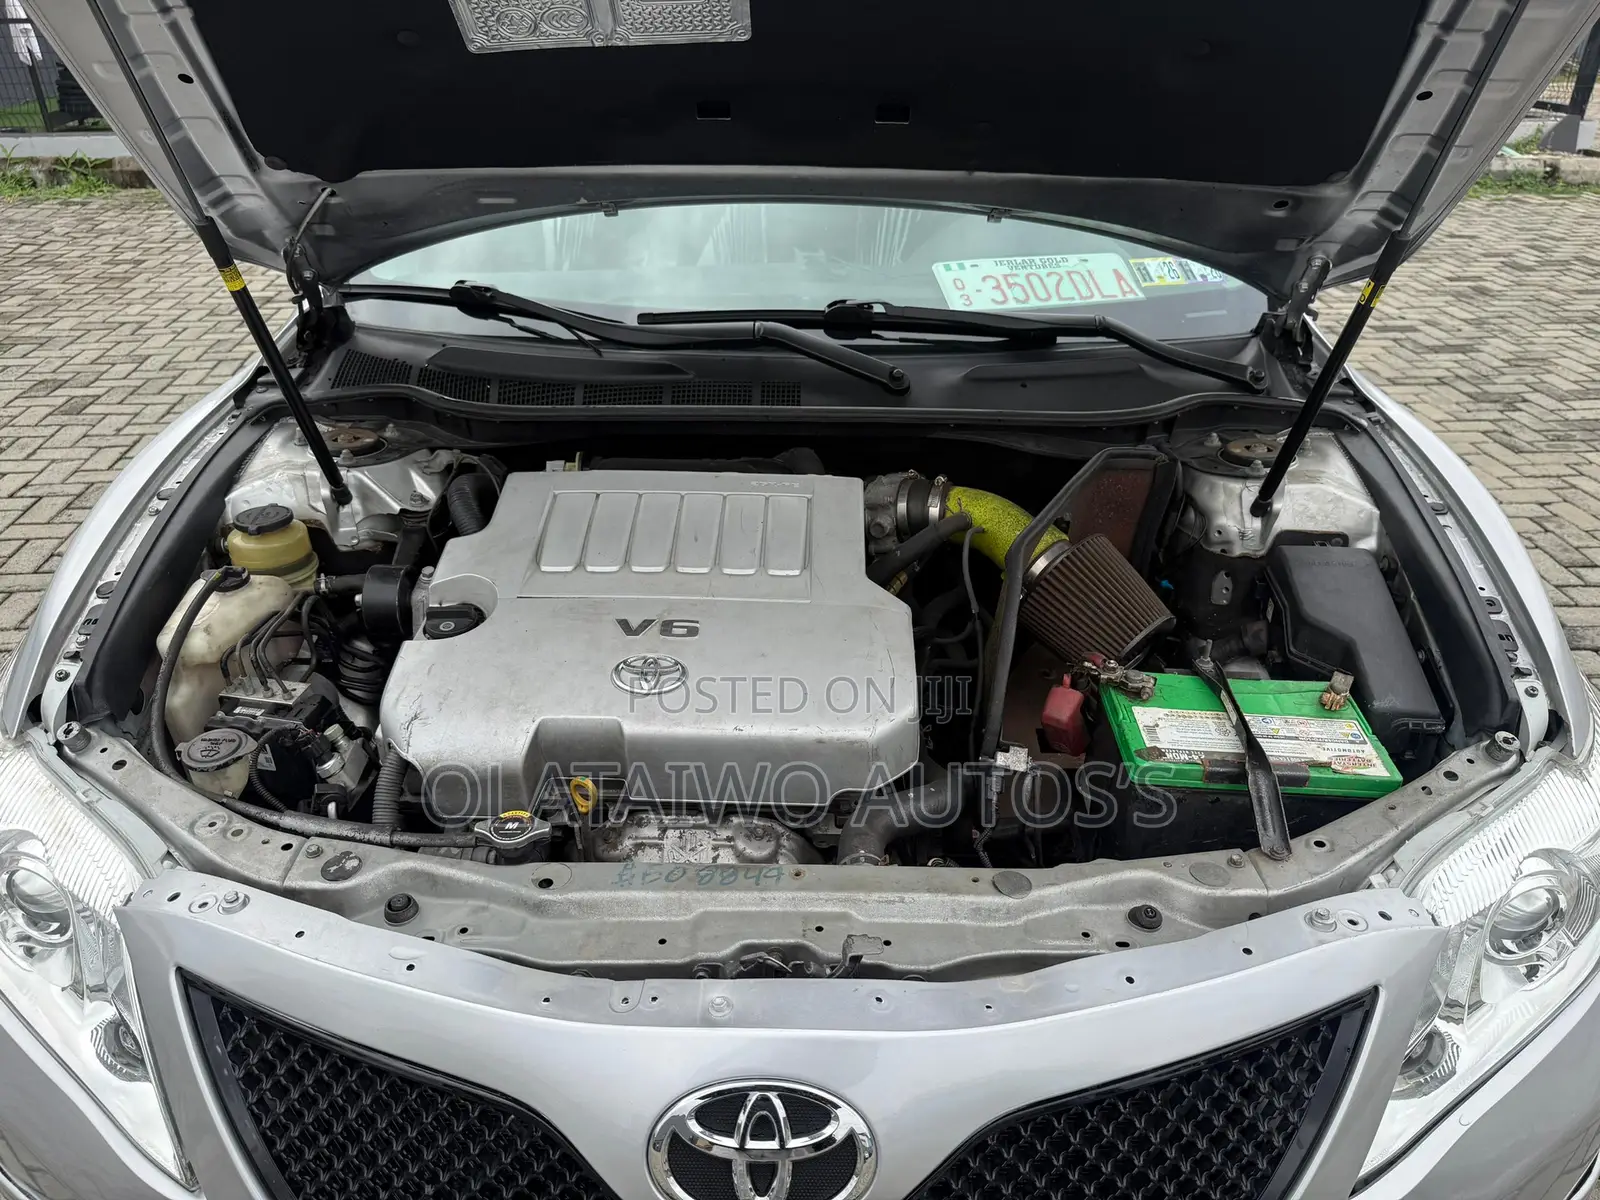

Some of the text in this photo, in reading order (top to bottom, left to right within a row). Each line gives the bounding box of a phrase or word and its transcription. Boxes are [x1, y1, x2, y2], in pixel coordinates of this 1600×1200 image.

[1163, 261, 1180, 279] 26
[614, 617, 700, 638] V6
[1321, 746, 1366, 754] AUTOMOTIVE
